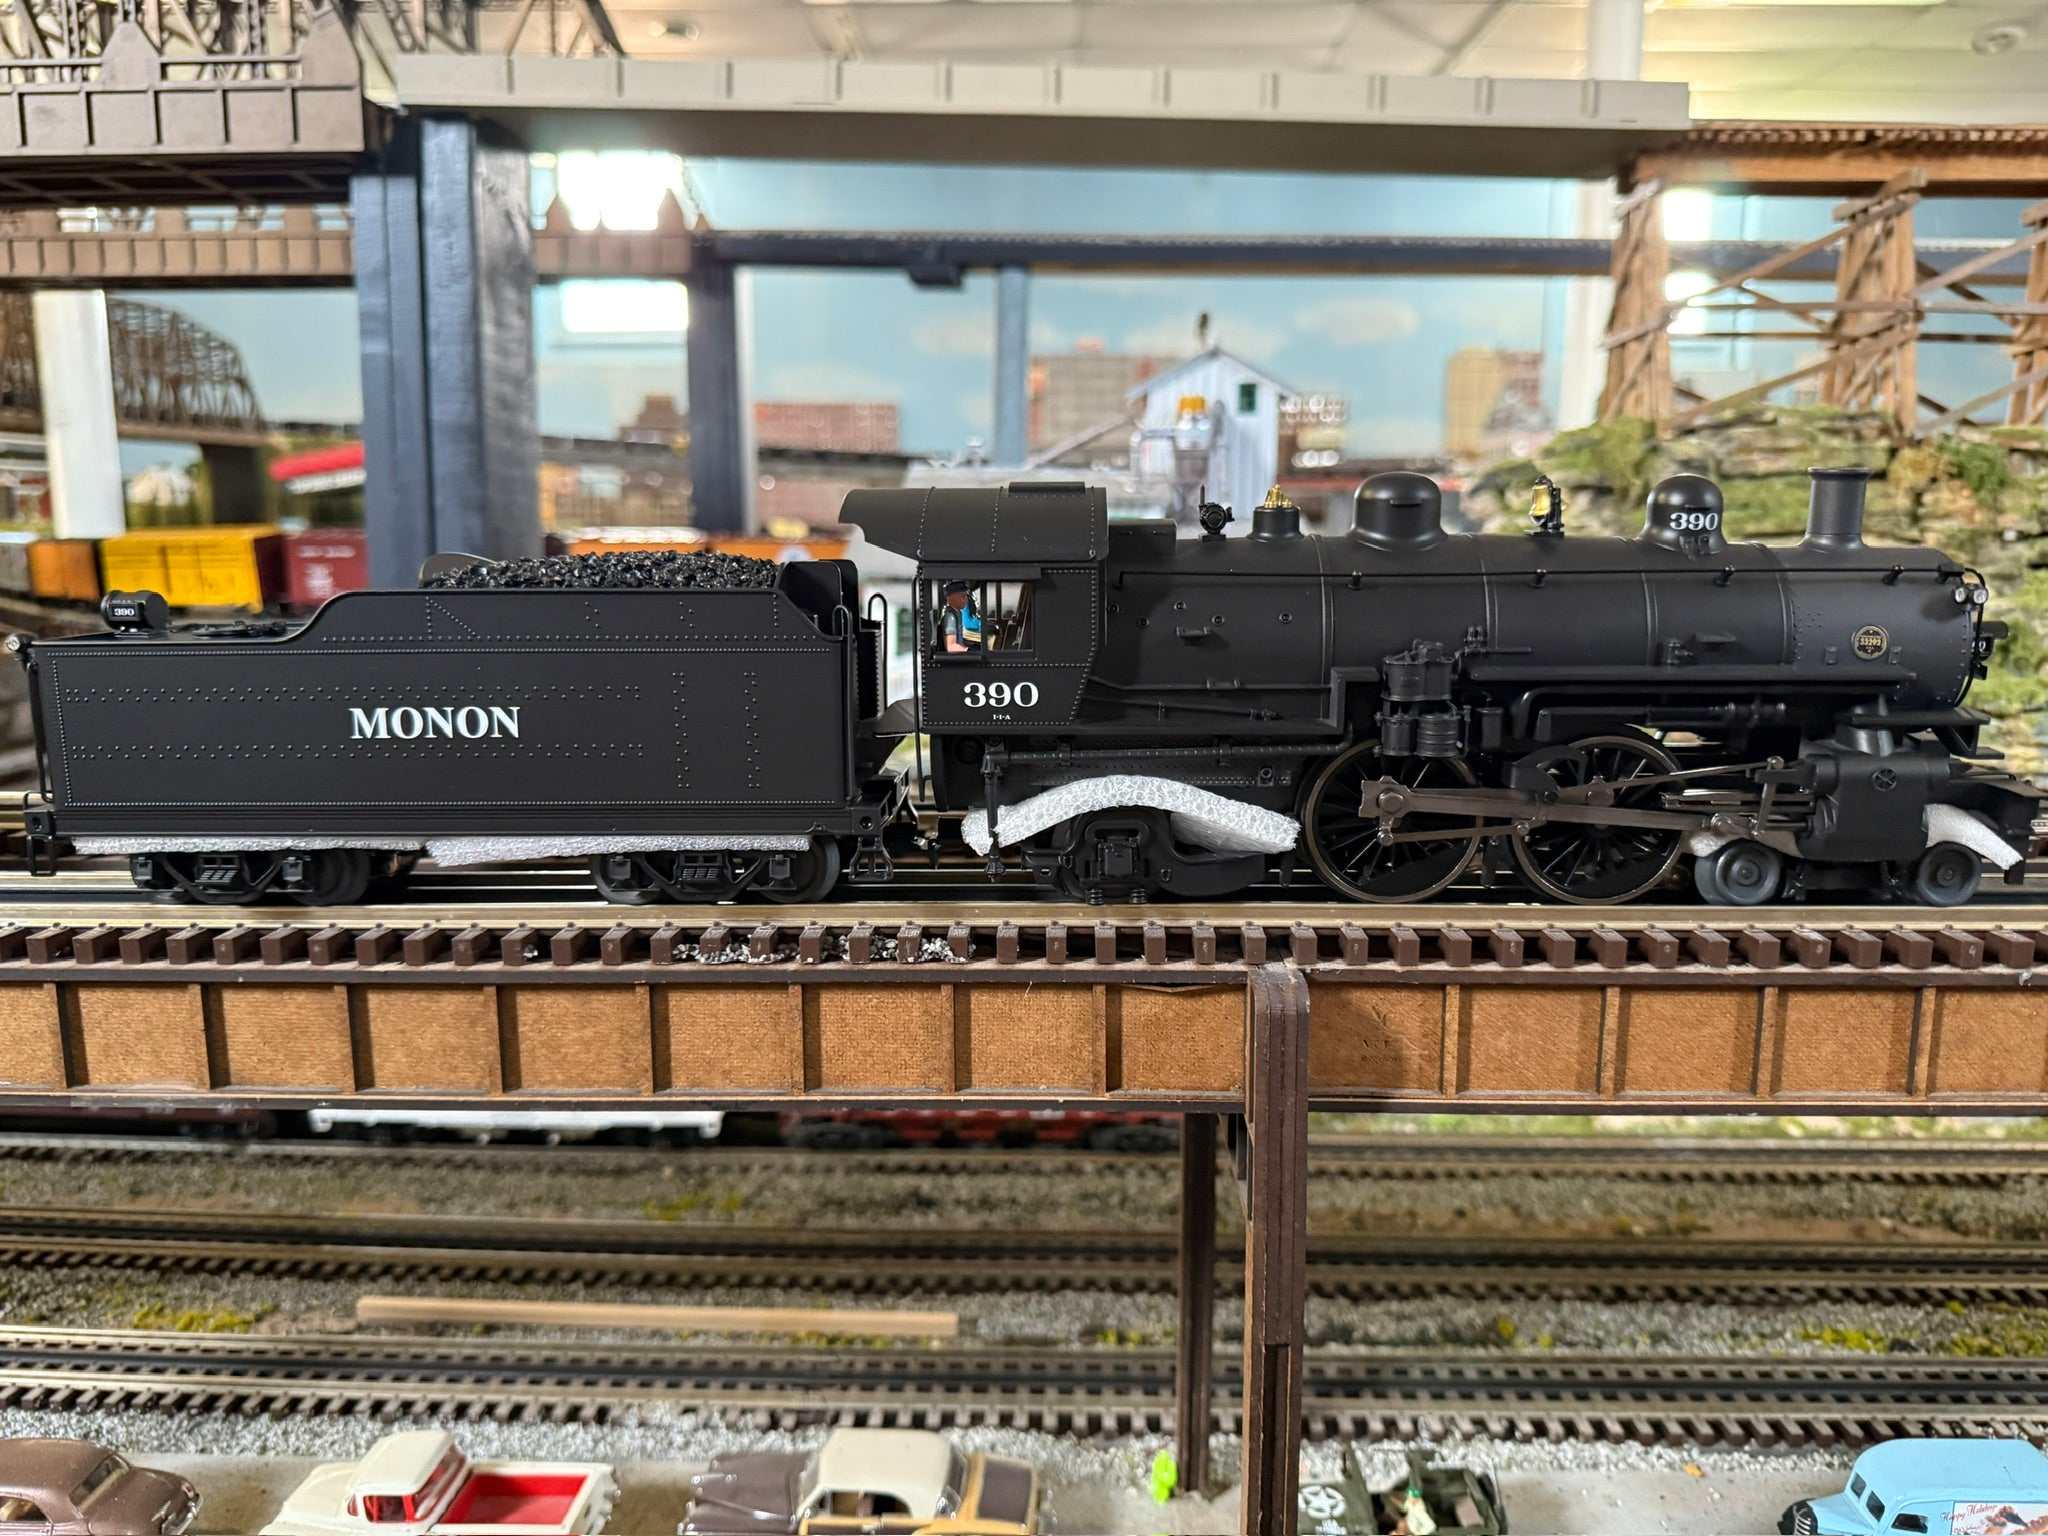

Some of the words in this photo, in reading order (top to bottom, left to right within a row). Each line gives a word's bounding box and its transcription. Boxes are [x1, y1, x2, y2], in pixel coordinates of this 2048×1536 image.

[1669, 512, 1719, 531] 390
[114, 608, 135, 616] 390
[963, 682, 1039, 708] 390
[348, 706, 521, 740] MONON
